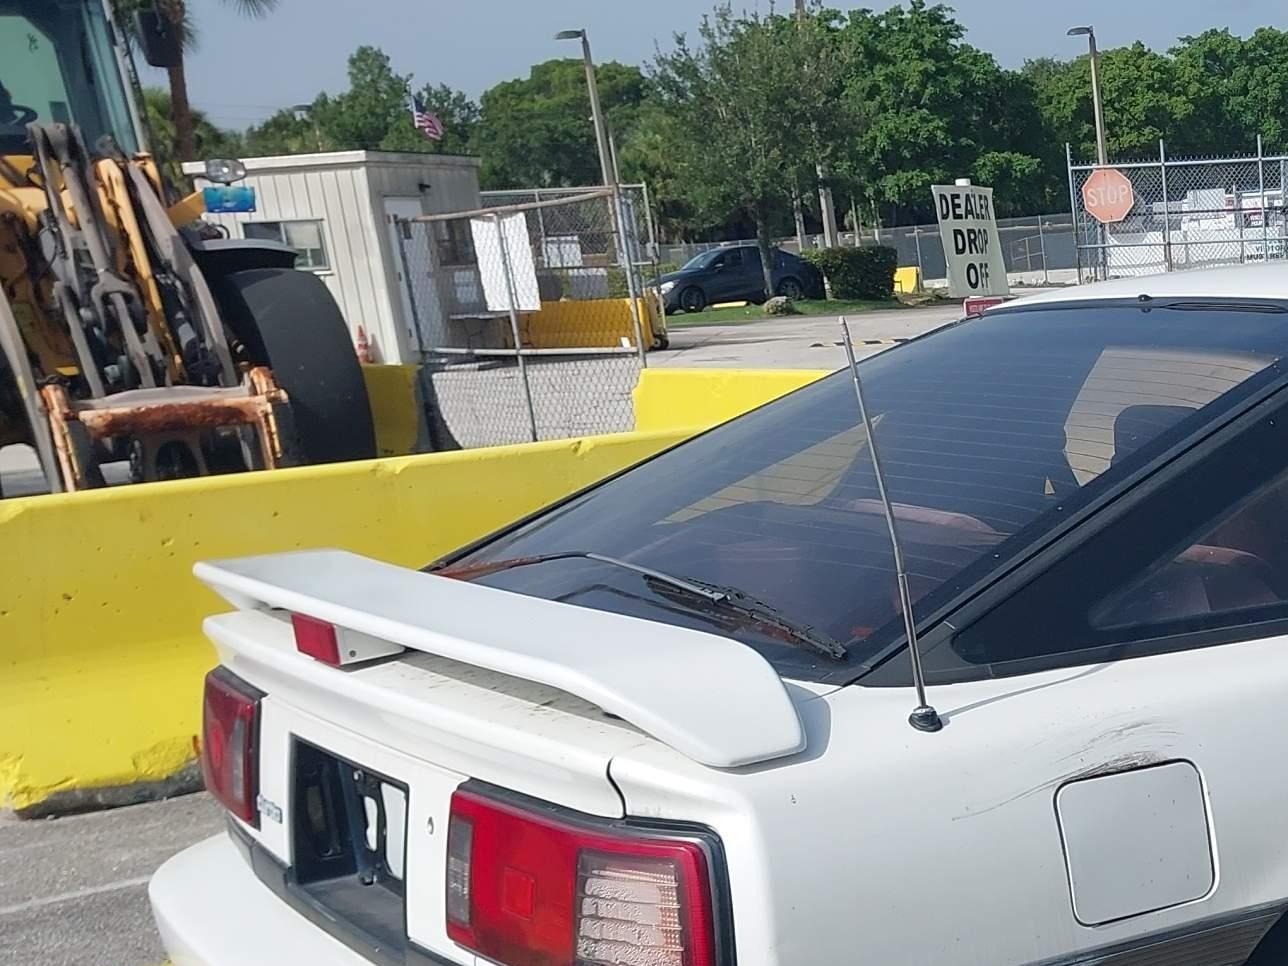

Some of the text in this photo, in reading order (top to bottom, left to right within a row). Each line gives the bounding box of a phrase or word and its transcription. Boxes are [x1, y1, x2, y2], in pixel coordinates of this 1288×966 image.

[939, 193, 991, 220] DEALER
[1087, 184, 1129, 207] STOP
[952, 228, 989, 255] DROP
[966, 262, 989, 289] OFF
